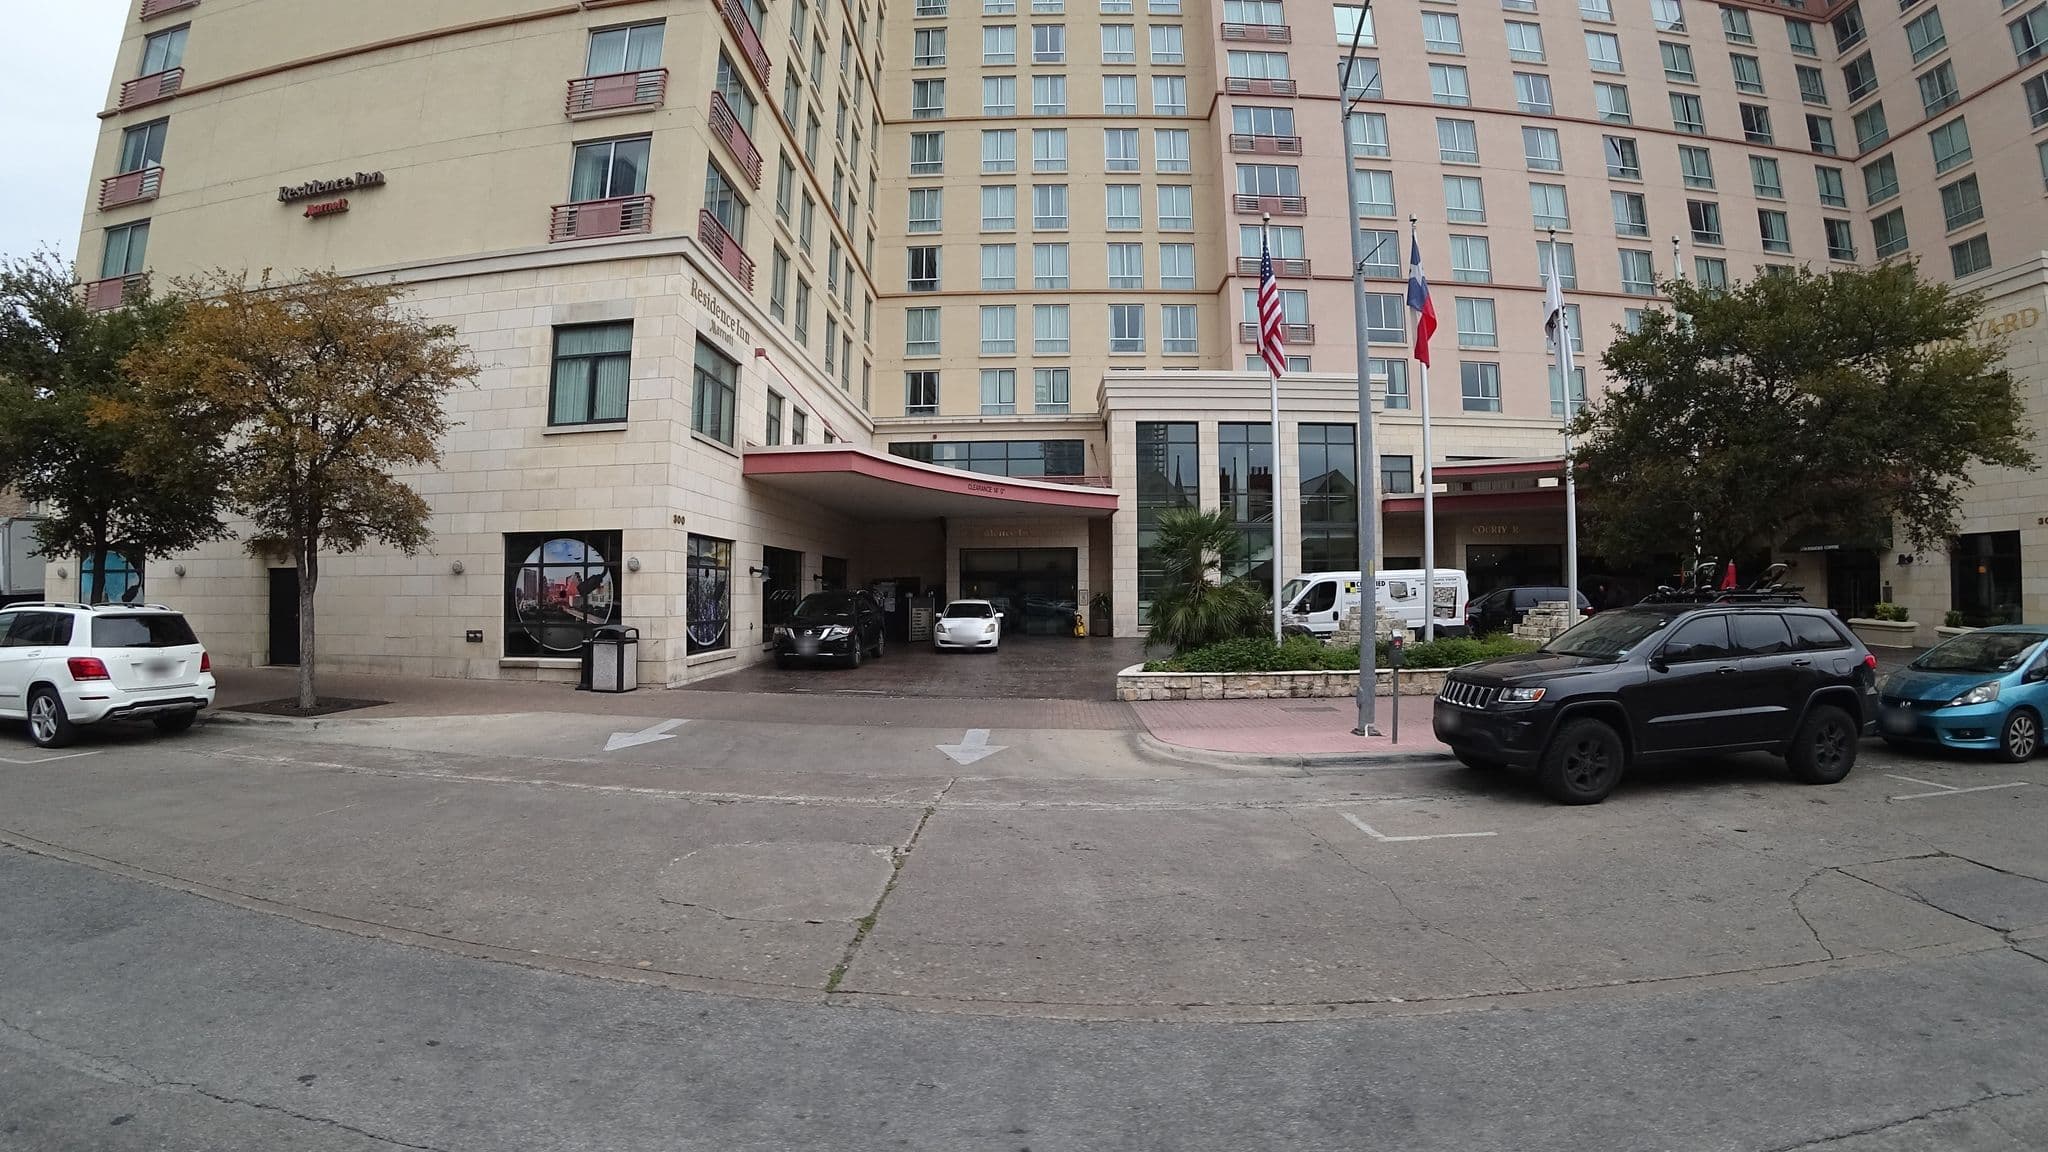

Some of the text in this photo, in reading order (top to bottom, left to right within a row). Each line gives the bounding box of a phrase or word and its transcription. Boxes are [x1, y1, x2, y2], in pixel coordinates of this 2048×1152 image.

[279, 170, 386, 204] Residence Inn
[690, 276, 750, 346] Residence Inn
[967, 483, 993, 493] CLEARANCE
